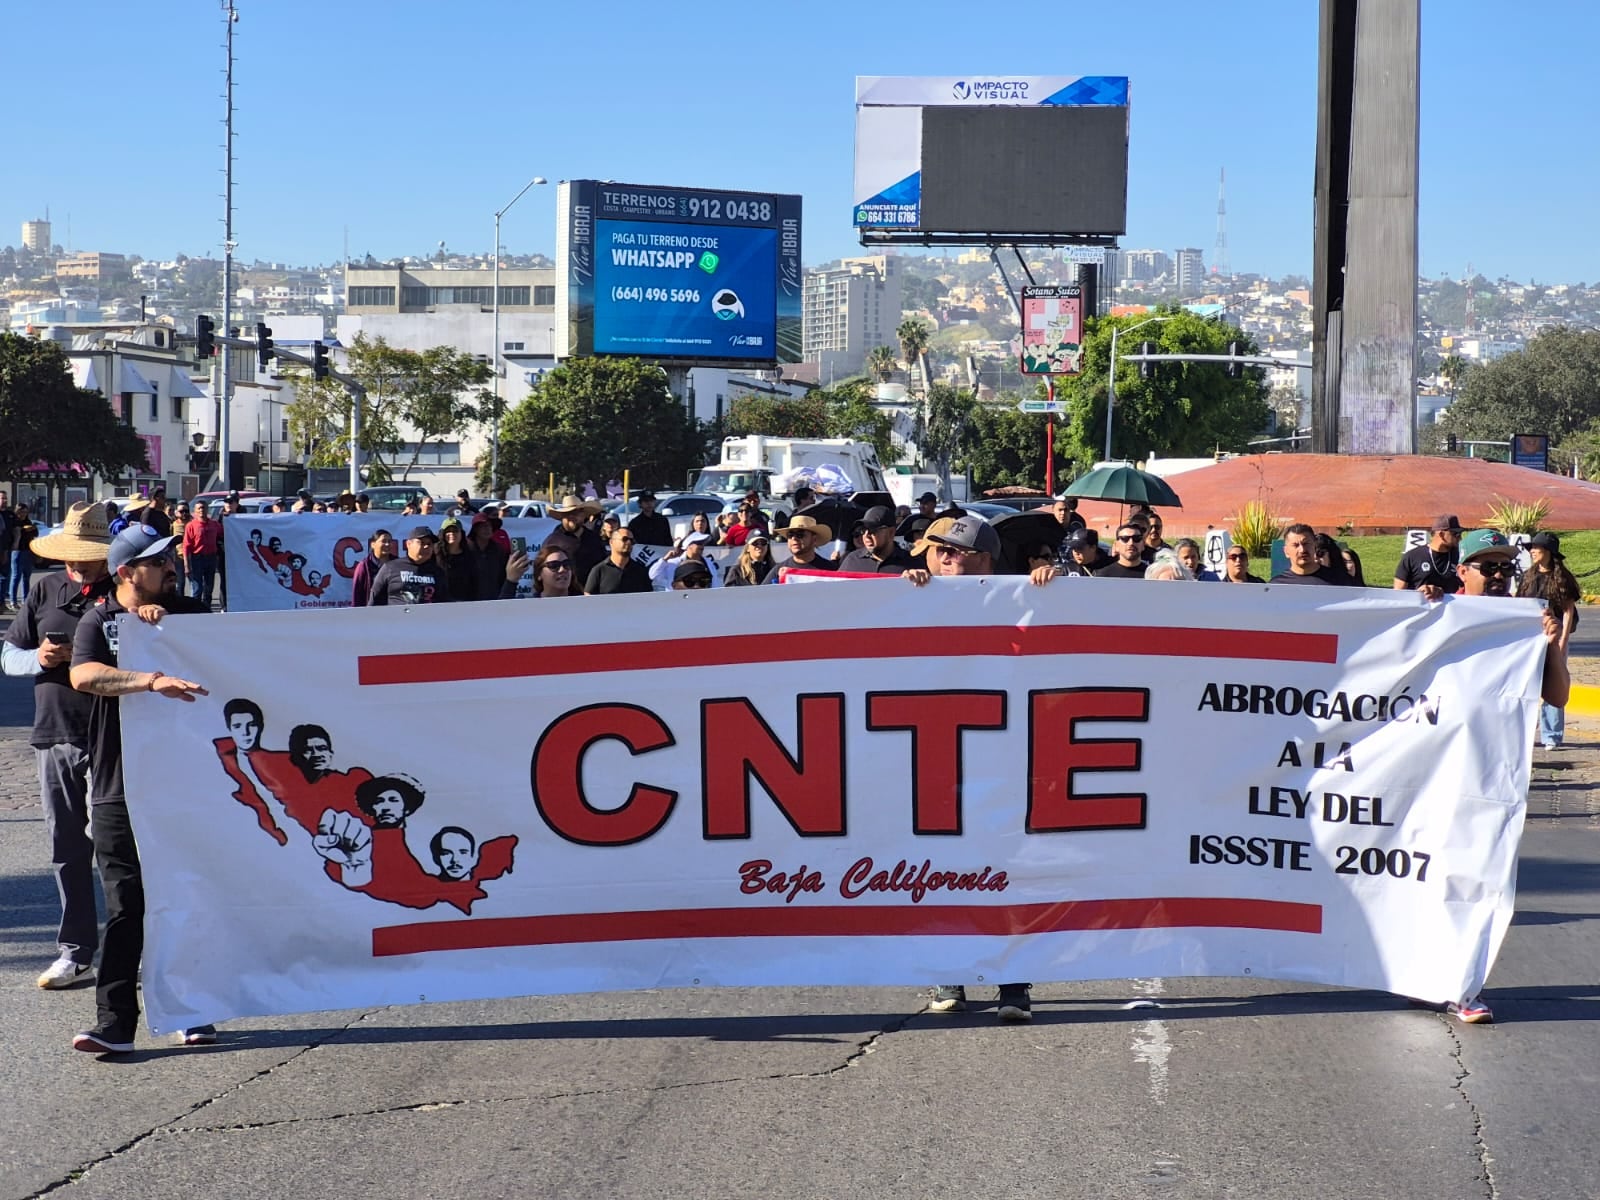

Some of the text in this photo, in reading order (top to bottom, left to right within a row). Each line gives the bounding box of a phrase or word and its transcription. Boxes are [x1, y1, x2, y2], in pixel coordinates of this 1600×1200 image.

[974, 82, 1029, 90] IMPACTO
[974, 91, 1029, 99] VISUAL
[603, 192, 676, 209] TERRENOS
[689, 198, 721, 218] 912
[726, 200, 771, 221] 0438
[574, 205, 591, 236] BAJA
[868, 211, 916, 223] 664 331 6786
[612, 232, 719, 249] PAGA TU TERRENO DESDE
[782, 218, 798, 248] BAJA
[571, 246, 592, 286] Vive
[611, 248, 695, 269] WHATSAPP
[780, 257, 800, 297] Vive
[1024, 286, 1080, 297] Sotano Suizo
[611, 285, 700, 303] (664) 496 5696
[1197, 683, 1442, 726] ABROGACIÓN
[530, 686, 1151, 847] CNTE
[1277, 740, 1355, 772] A LA
[1248, 786, 1395, 827] LEY DEL
[1189, 834, 1432, 882] ISSSTE 2007
[738, 856, 1010, 904] Baja California
